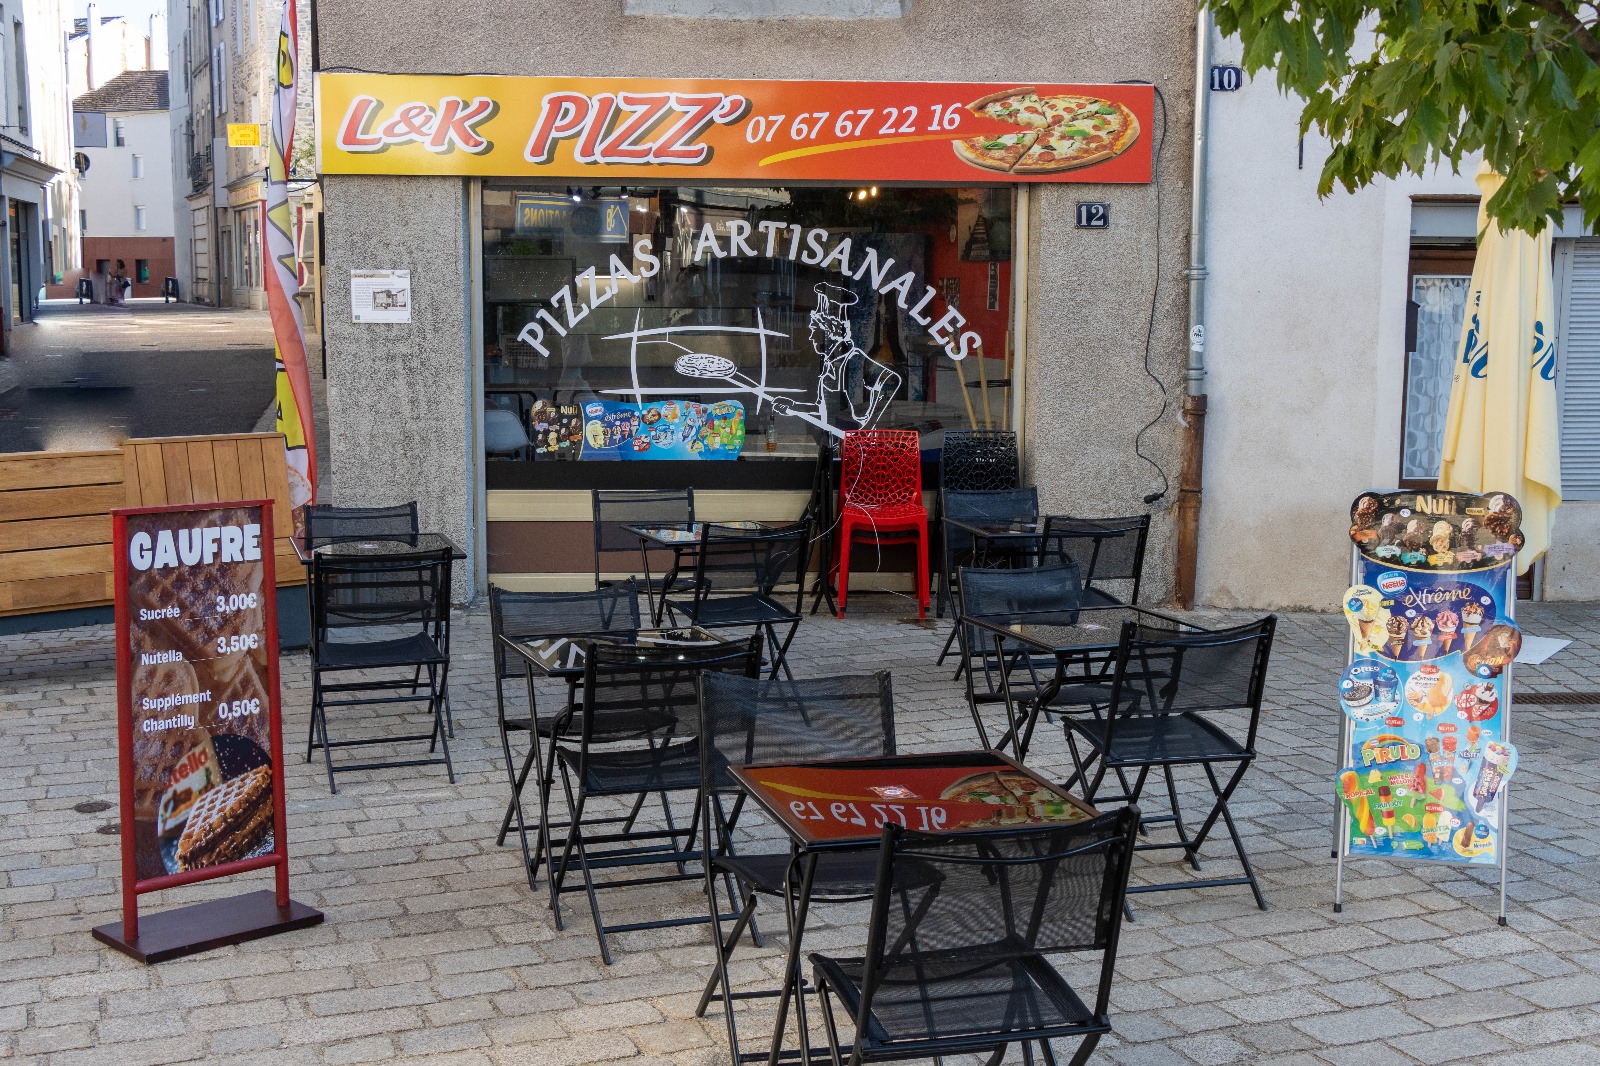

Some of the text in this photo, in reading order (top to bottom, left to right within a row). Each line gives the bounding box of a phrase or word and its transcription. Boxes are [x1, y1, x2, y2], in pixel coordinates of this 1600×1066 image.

[1212, 68, 1237, 90] 10
[335, 94, 500, 155] L&K
[745, 102, 963, 144] 07 67 67 22 16
[1080, 204, 1104, 226] 12
[517, 219, 982, 361] PIZZAS ARTISANALES
[1416, 495, 1456, 515] Nuii
[130, 524, 262, 570] GAUFRE
[140, 605, 181, 621] Sucrée
[216, 592, 257, 614] 3,00€
[217, 633, 259, 654] 3,50€
[141, 650, 183, 666] Nutella
[1351, 666, 1380, 675] OREO
[142, 689, 212, 711] Supplément
[218, 698, 260, 720] 0,50€
[143, 714, 195, 733] Chantilly
[1342, 788, 1375, 800] TROPICAL
